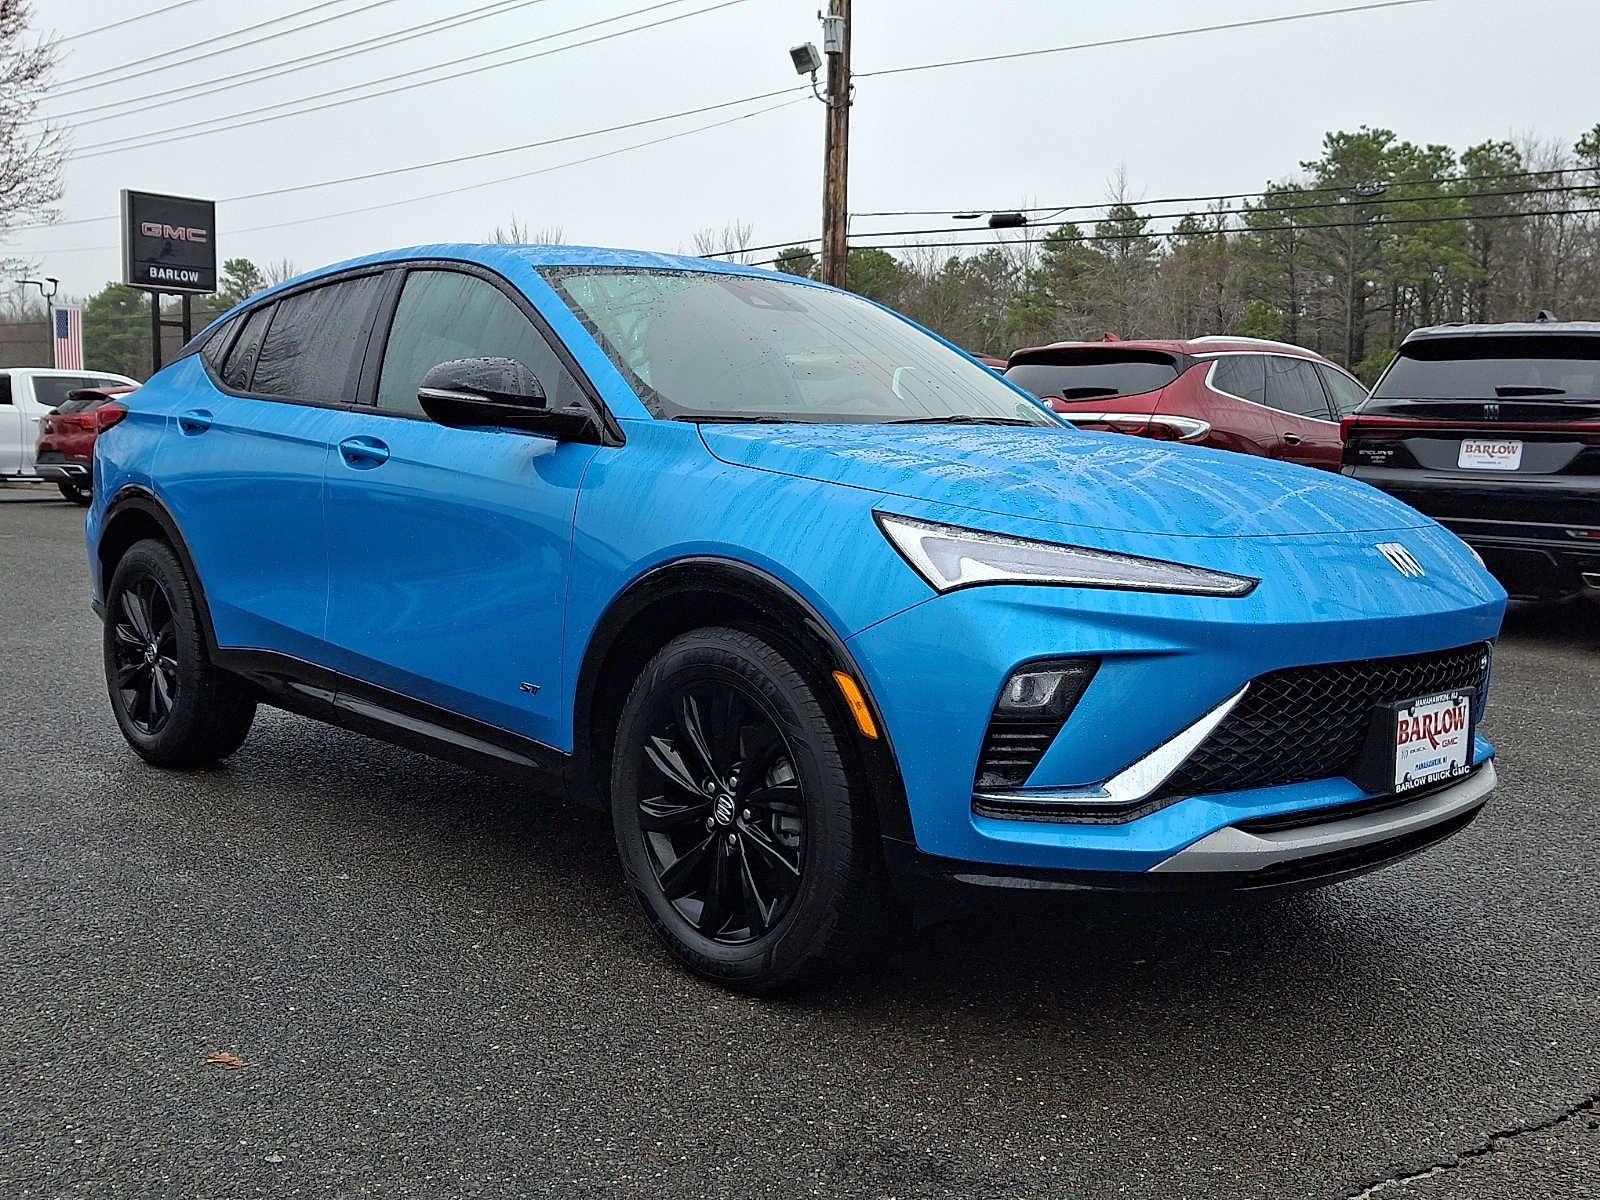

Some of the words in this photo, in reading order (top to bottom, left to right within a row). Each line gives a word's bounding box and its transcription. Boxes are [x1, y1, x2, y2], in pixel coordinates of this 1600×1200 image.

[141, 222, 207, 243] GMC
[149, 267, 199, 283] BARLOW
[1465, 444, 1518, 458] BARLOW
[519, 681, 541, 695] ST
[1398, 705, 1467, 750] BARLOW
[1442, 737, 1458, 747] GMC
[1396, 777, 1427, 793] BARLOW
[1427, 770, 1450, 784] BUICK
[1452, 765, 1471, 776] GMC
